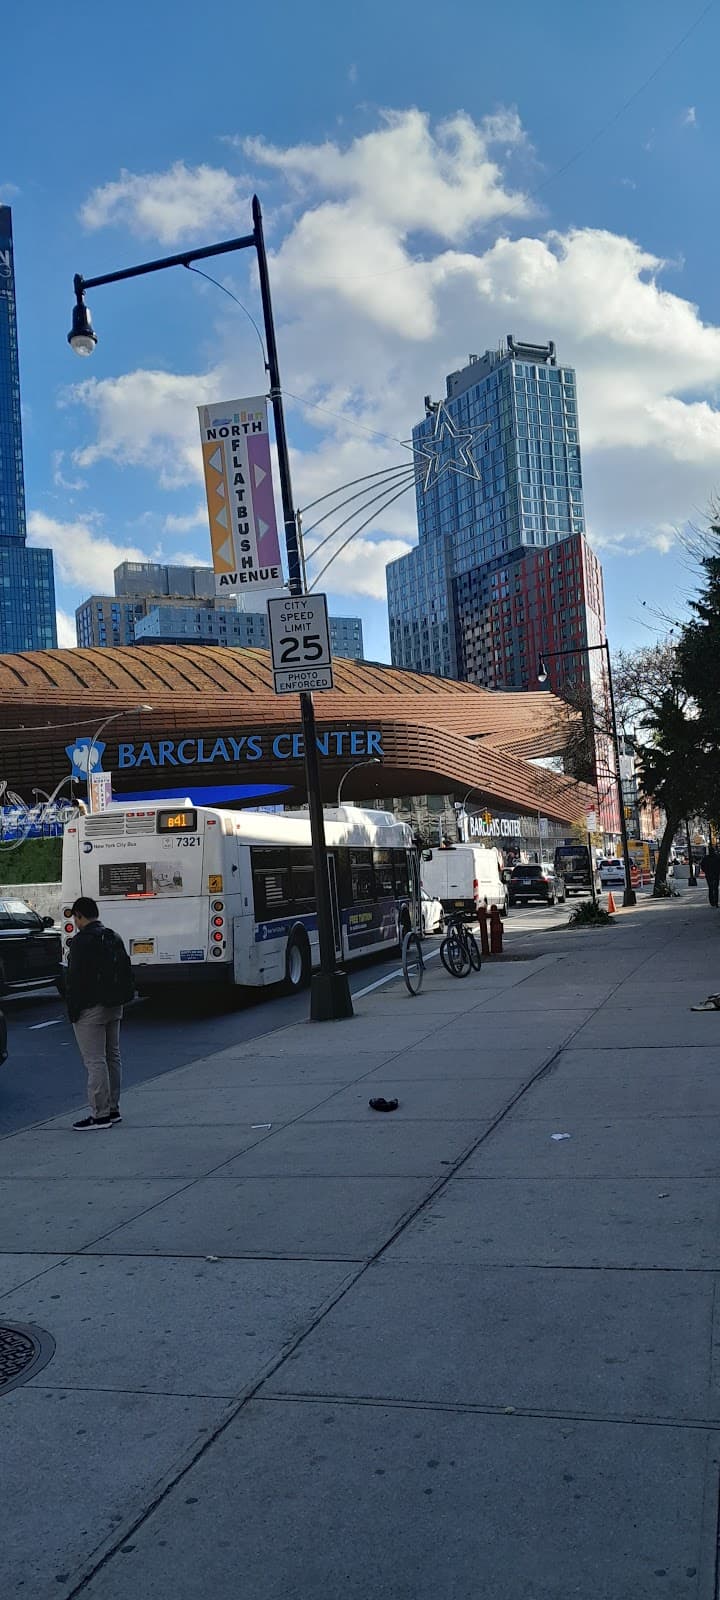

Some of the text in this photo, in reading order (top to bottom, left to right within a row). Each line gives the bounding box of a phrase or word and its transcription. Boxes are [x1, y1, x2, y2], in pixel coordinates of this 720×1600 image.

[206, 421, 262, 441] NORTH
[231, 439, 253, 570] FLATBUSH
[219, 567, 279, 587] AVENUE
[284, 601, 308, 611] CITY
[280, 611, 314, 622] SPEED
[284, 622, 312, 633] LIMIT
[280, 634, 323, 664] 25
[288, 671, 318, 682] PHOTO
[280, 679, 328, 690] ENFORCED
[118, 736, 264, 768] BARCLAYS
[500, 818, 521, 837] CENTER
[175, 836, 201, 848] 7321
